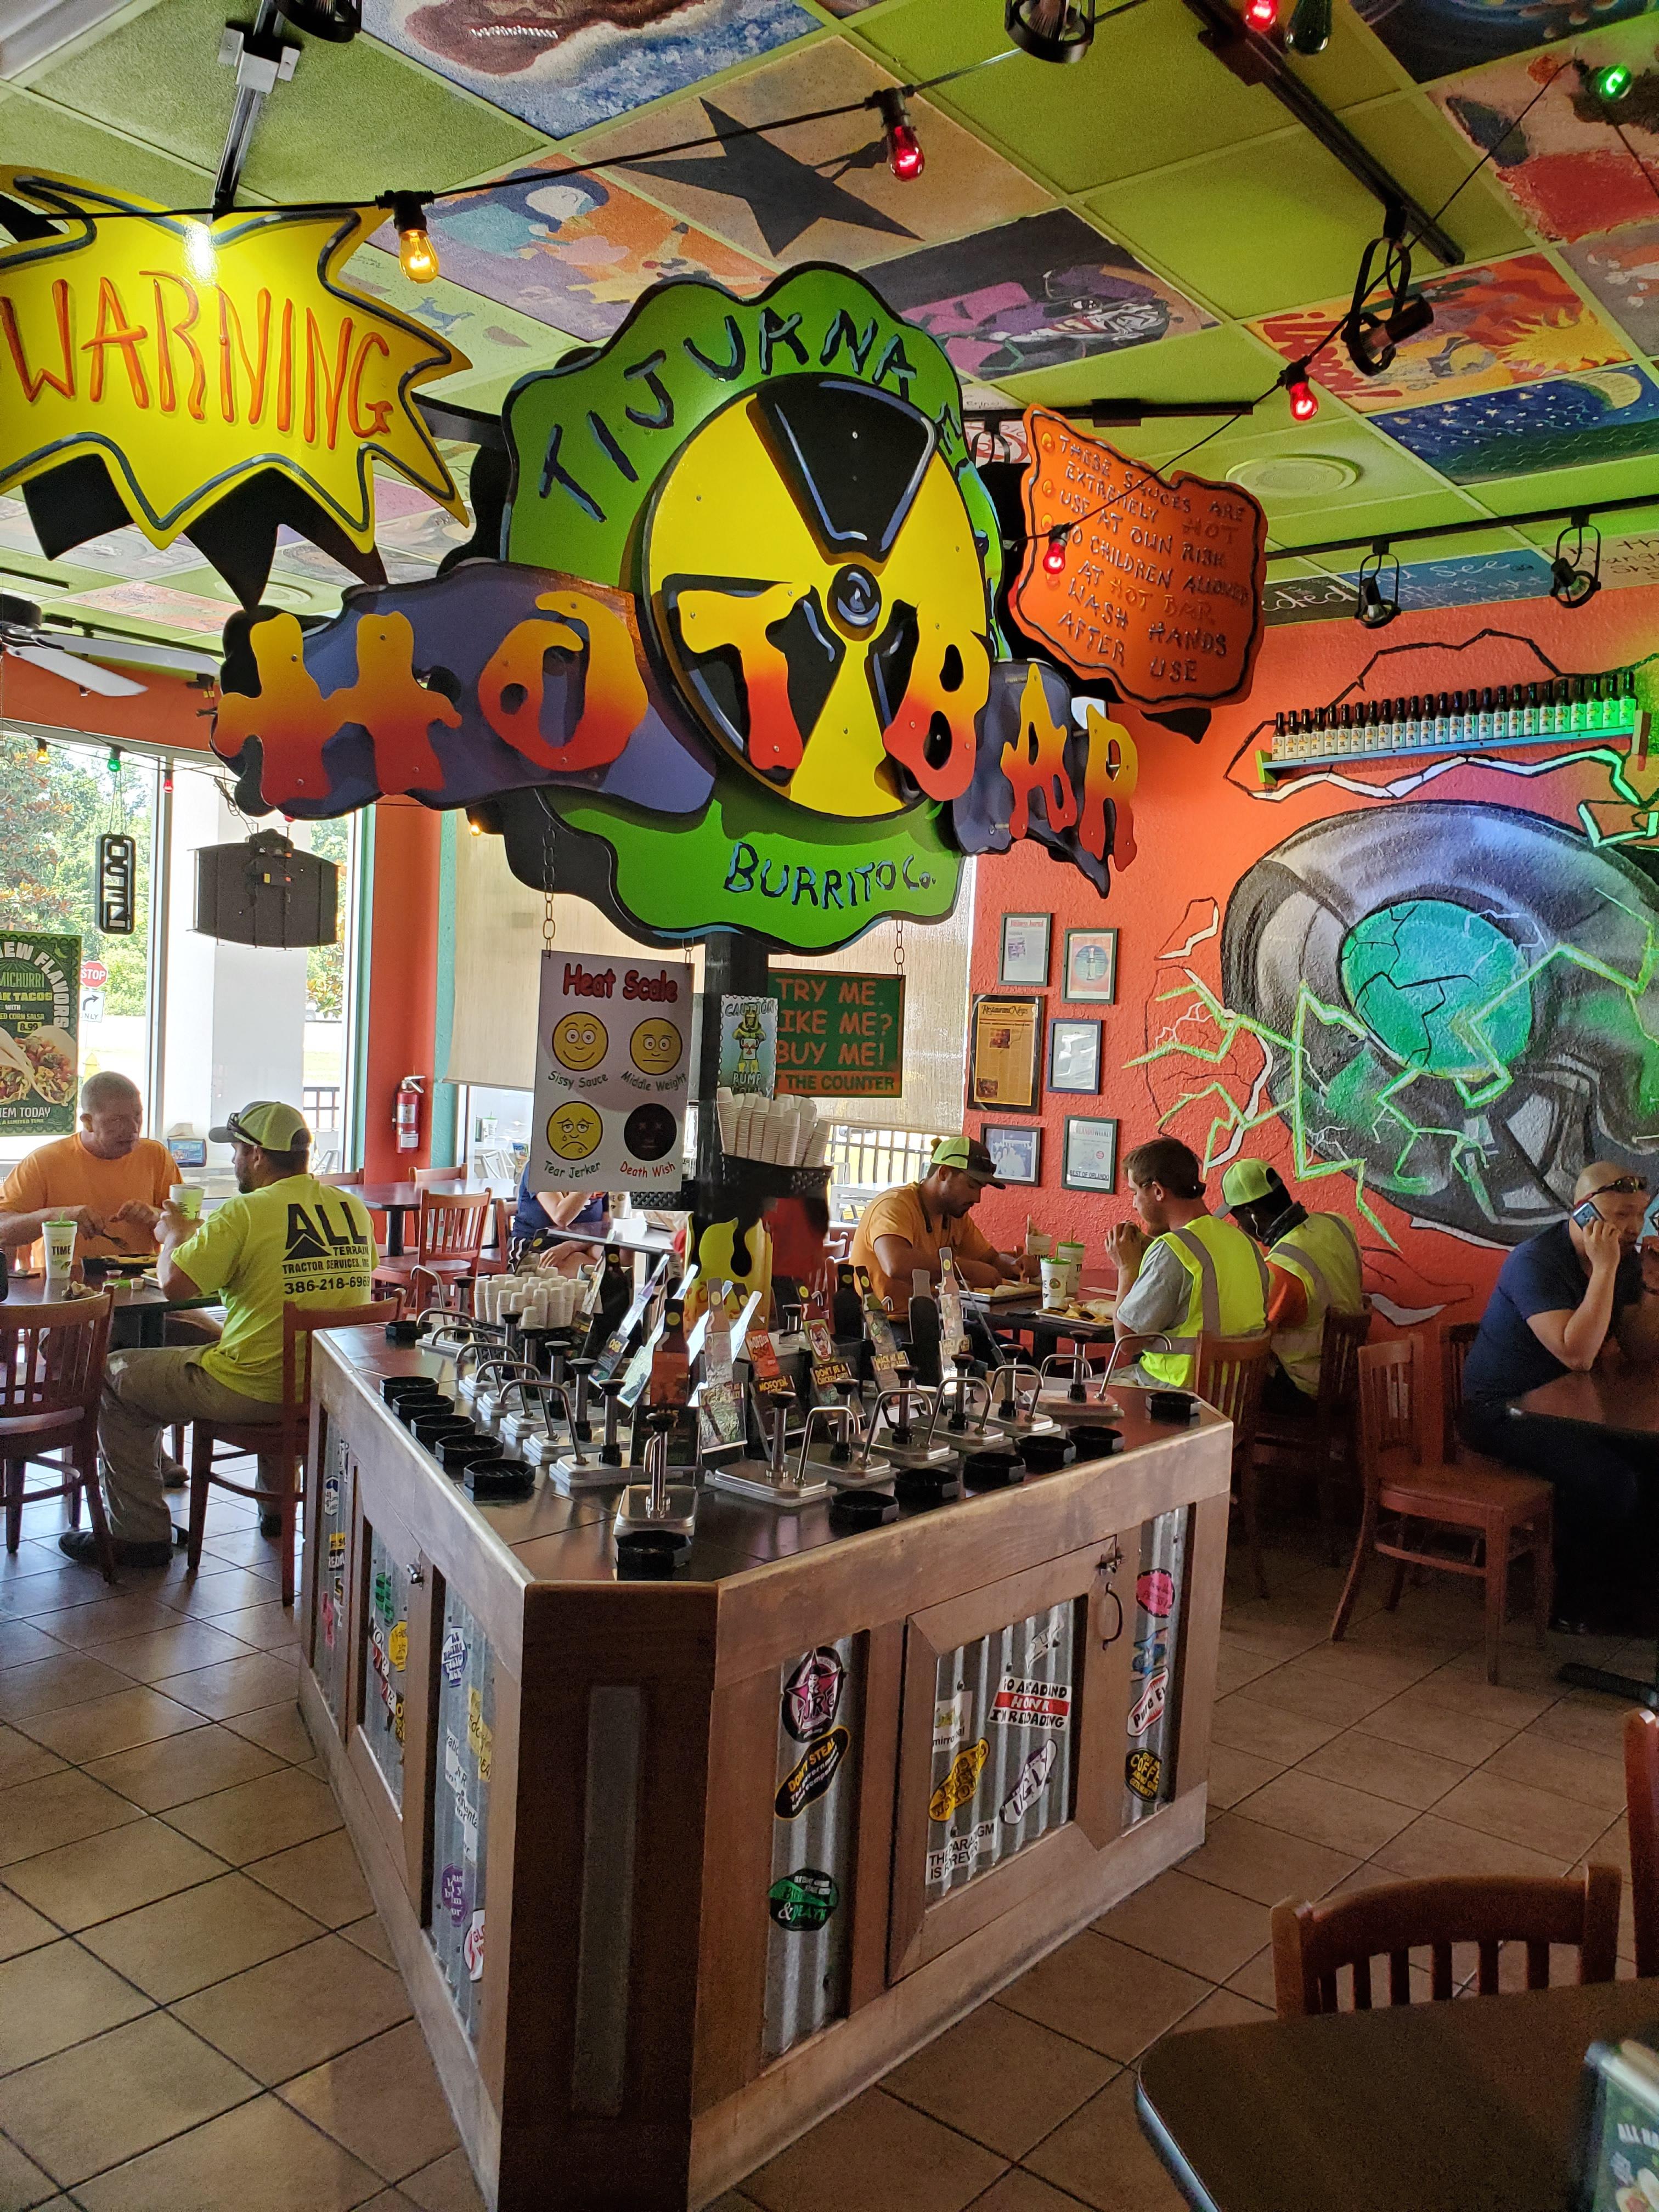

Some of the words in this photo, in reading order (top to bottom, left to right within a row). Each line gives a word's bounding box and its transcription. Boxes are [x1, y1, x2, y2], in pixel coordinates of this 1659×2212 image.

[0, 270, 393, 450] WARNING
[1058, 435, 1111, 479] THESE
[1123, 472, 1192, 513] SAUCES
[1209, 499, 1246, 522] ARE
[1065, 461, 1159, 523] EXTREMELY
[1183, 518, 1240, 545] HOT
[1059, 489, 1091, 516] USE
[1097, 506, 1124, 534] AT
[1130, 527, 1173, 557] OWN
[1182, 542, 1227, 567] RISK
[1091, 534, 1175, 590] CHILDREN
[1182, 575, 1250, 606] ALLOWED
[1077, 560, 1105, 585] AT
[1109, 577, 1154, 611] HOT
[1164, 594, 1215, 625] BAR
[1068, 577, 1129, 631] WASH
[1148, 623, 1227, 656] HANDS
[1058, 609, 1126, 667] AFTER
[1149, 657, 1198, 683] USE
[213, 583, 811, 805] HOT
[883, 601, 1138, 871] BAR
[723, 842, 896, 910] BURRITO
[81, 968, 106, 980] STOP
[563, 963, 617, 998] Heat
[623, 970, 678, 1003] Scale
[13, 992, 52, 1001] TACOS
[34, 952, 69, 1028] FLAVORS
[776, 978, 827, 1002] TRY
[725, 1000, 775, 1017] CAUTION
[777, 1009, 828, 1034] IKE
[839, 1011, 893, 1036] ME?
[776, 1040, 827, 1065] BUY
[838, 1042, 884, 1066] ME!
[548, 1071, 574, 1091] Sissy
[579, 1074, 608, 1088] Sauce
[620, 1071, 651, 1091] Middle
[656, 1073, 687, 1091] Weight
[732, 1071, 762, 1086] PUMP
[786, 1075, 817, 1090] THE
[821, 1075, 895, 1091] COUNTER
[19, 1107, 51, 1118] TODAY
[544, 1160, 565, 1178] Tear
[568, 1162, 600, 1178] Jerker
[620, 1161, 648, 1178] Death
[652, 1162, 676, 1178] Wish
[285, 1201, 368, 1250] ALL
[52, 1245, 71, 1256] TIME
[333, 1246, 368, 1256] TERRAIN
[283, 1261, 324, 1274] TRACTOR
[815, 1366, 832, 1378] DON'T
[1011, 1695, 1050, 1712] HONK
[1133, 1696, 1154, 1728] Pure
[809, 1738, 836, 1765] STEAL
[930, 1866, 942, 1880] IS
